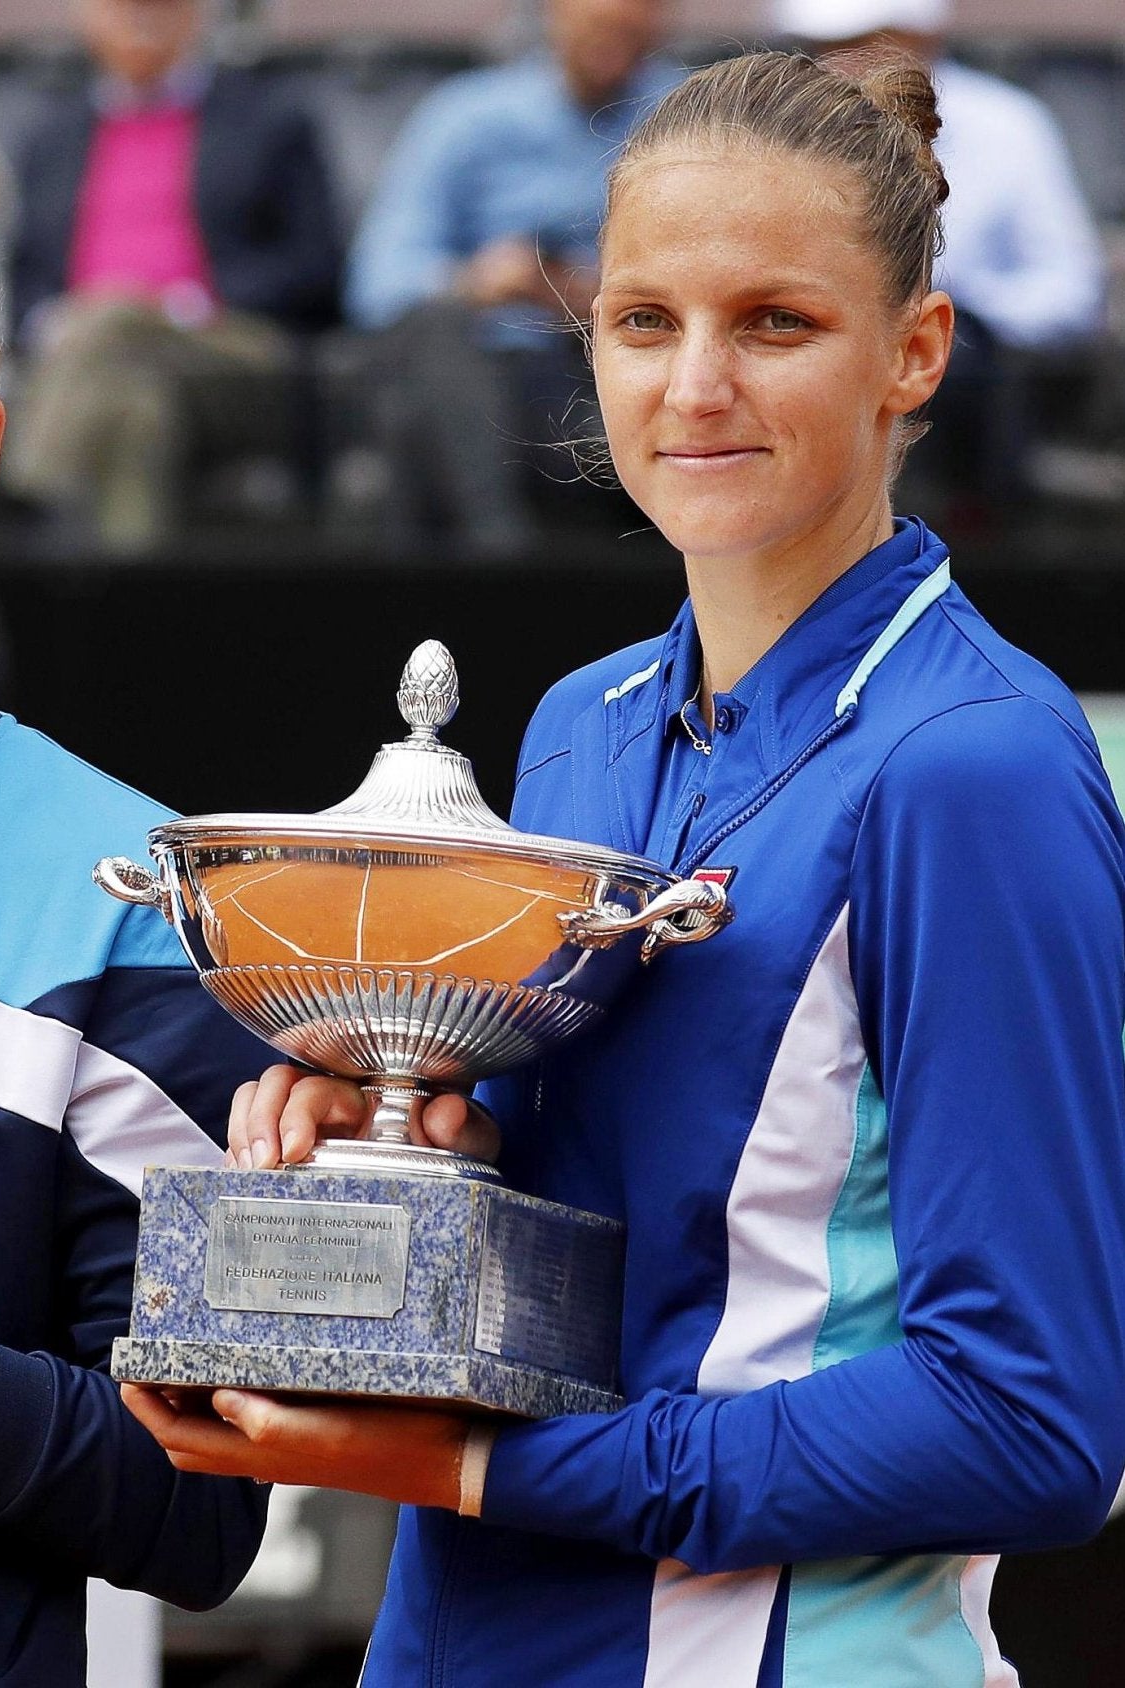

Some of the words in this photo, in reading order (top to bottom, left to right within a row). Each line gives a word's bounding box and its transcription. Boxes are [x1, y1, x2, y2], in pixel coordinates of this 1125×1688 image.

[224, 1212, 295, 1226] CAMPIONATI
[299, 1217, 393, 1231] INTERNAZIONALI
[252, 1232, 299, 1245] D'ITALIA
[303, 1236, 361, 1248] FEMMINILI
[226, 1266, 316, 1283] FEDERAZIONE
[322, 1271, 383, 1285] ITALIANA
[278, 1287, 327, 1302] TENNIS
